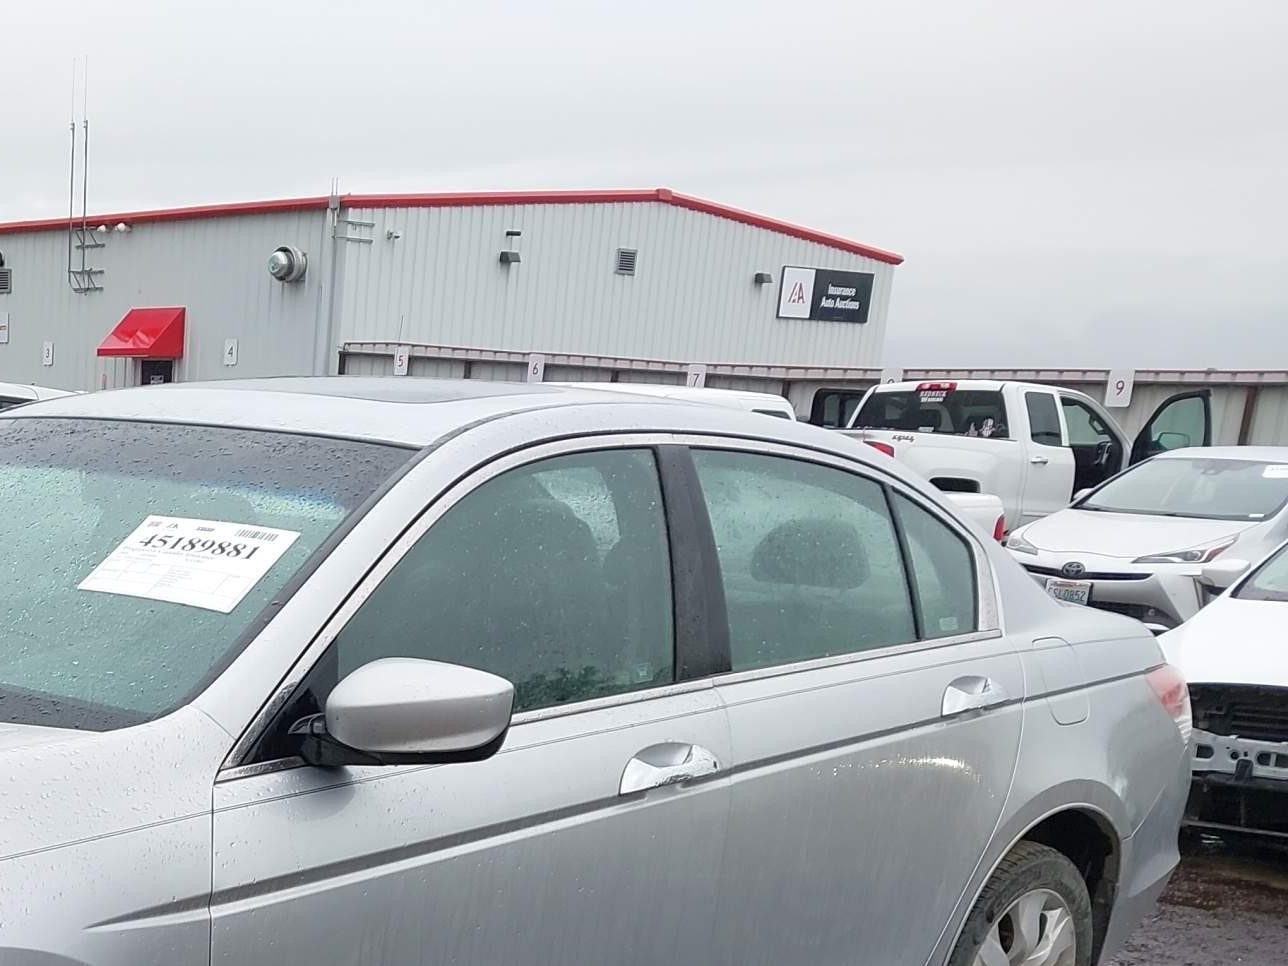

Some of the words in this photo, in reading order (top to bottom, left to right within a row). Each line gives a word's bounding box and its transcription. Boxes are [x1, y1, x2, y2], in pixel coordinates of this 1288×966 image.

[827, 283, 856, 297] Insurance
[820, 296, 835, 308] Auto
[834, 297, 860, 310] Auctions
[45, 347, 51, 359] 3
[227, 345, 234, 358] 4
[397, 354, 404, 368] 5
[532, 361, 539, 376] 6
[692, 373, 700, 387] 7
[1115, 380, 1125, 396] 9
[139, 534, 260, 560] 45189881
